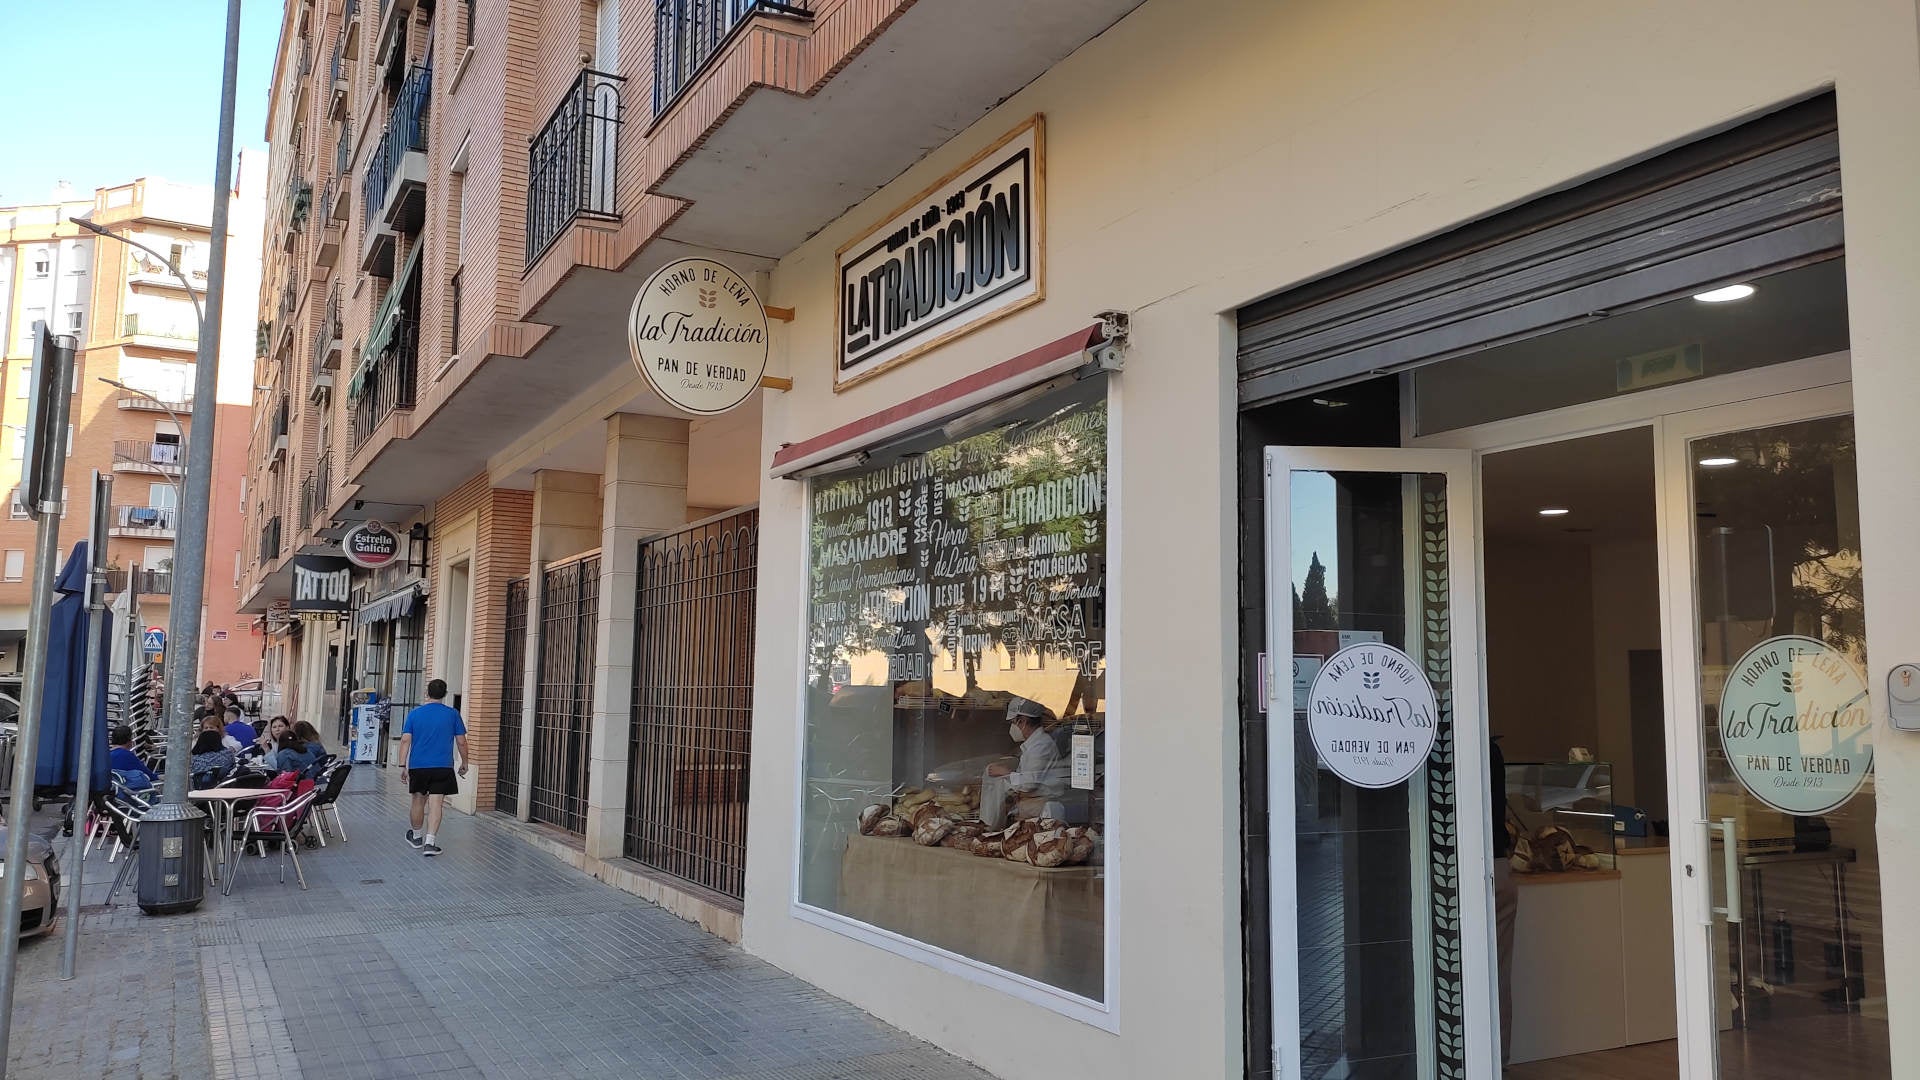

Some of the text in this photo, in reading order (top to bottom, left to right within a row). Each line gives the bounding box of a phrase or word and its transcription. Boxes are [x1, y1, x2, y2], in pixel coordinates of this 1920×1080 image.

[659, 268, 751, 307] HORNO DE LEÑA
[658, 357, 746, 382] PAN DE VERDAD
[680, 378, 724, 391] Desde 1913
[815, 457, 935, 515] HARINAS ECOLÓGICAS
[933, 475, 944, 515] DESDE
[866, 495, 893, 531] 1913
[914, 497, 922, 544] MASA
[920, 484, 929, 542] MADRE
[354, 533, 393, 545] Estrella
[356, 542, 390, 553] Galicia
[929, 520, 968, 554] Horno
[1028, 532, 1071, 559] HARINAS
[1028, 552, 1088, 580] ECOLÓGICAS
[295, 563, 351, 602] TATTOO
[936, 583, 965, 608] DESDE
[1026, 582, 1046, 604] Pan
[297, 612, 342, 621] SINCE 1997
[1020, 604, 1086, 640] MASA
[1741, 648, 1847, 687] HORNO DE LEÑA
[1747, 756, 1850, 775] PAN DE VERDAD
[1773, 776, 1824, 788] Desde 1913
